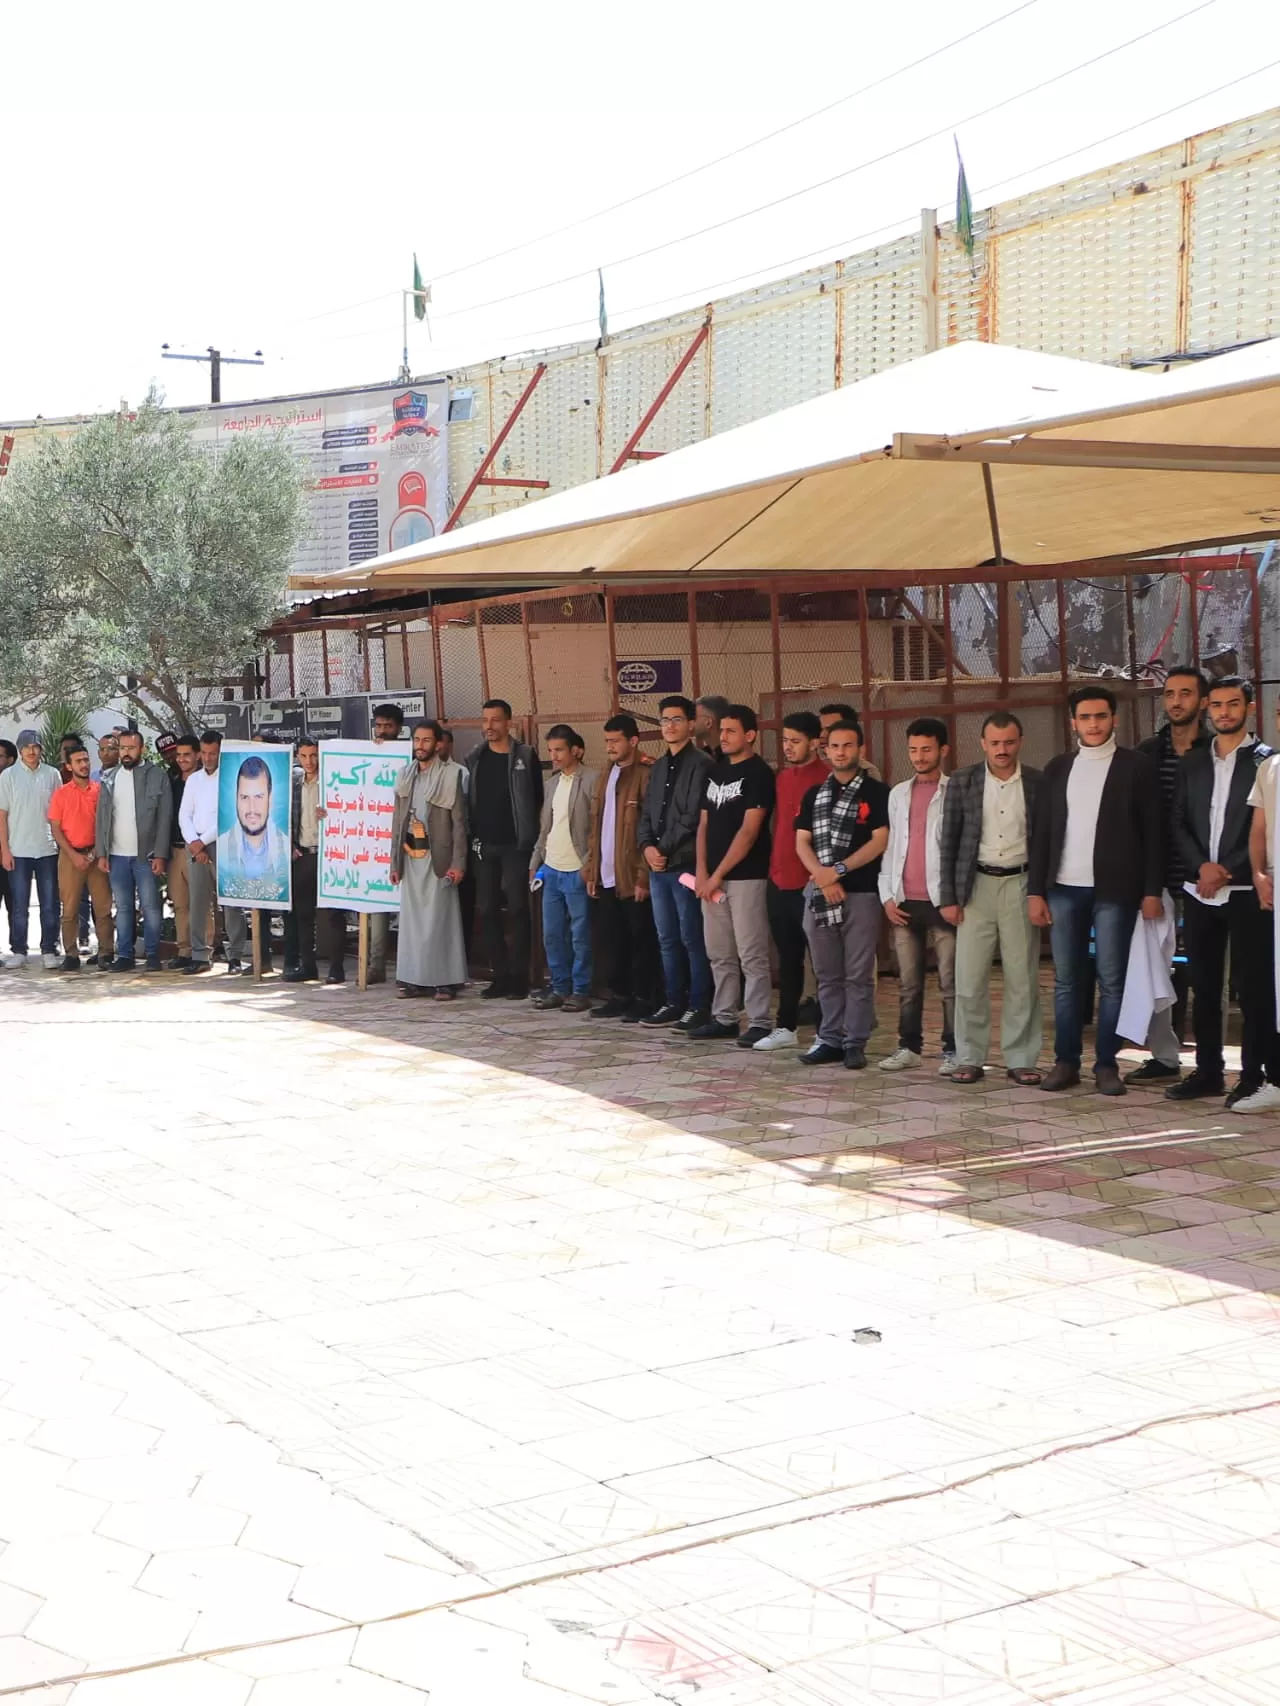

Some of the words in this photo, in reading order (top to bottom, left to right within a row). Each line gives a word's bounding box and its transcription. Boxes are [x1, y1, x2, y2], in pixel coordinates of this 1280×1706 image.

[326, 759, 372, 791] أكبر
[373, 764, 398, 788] لله
[326, 792, 364, 814] لأمريكا
[325, 818, 364, 841] لإسرائيل
[324, 845, 350, 863] اليهود
[352, 848, 370, 865] على
[323, 866, 360, 895] للإسلام
